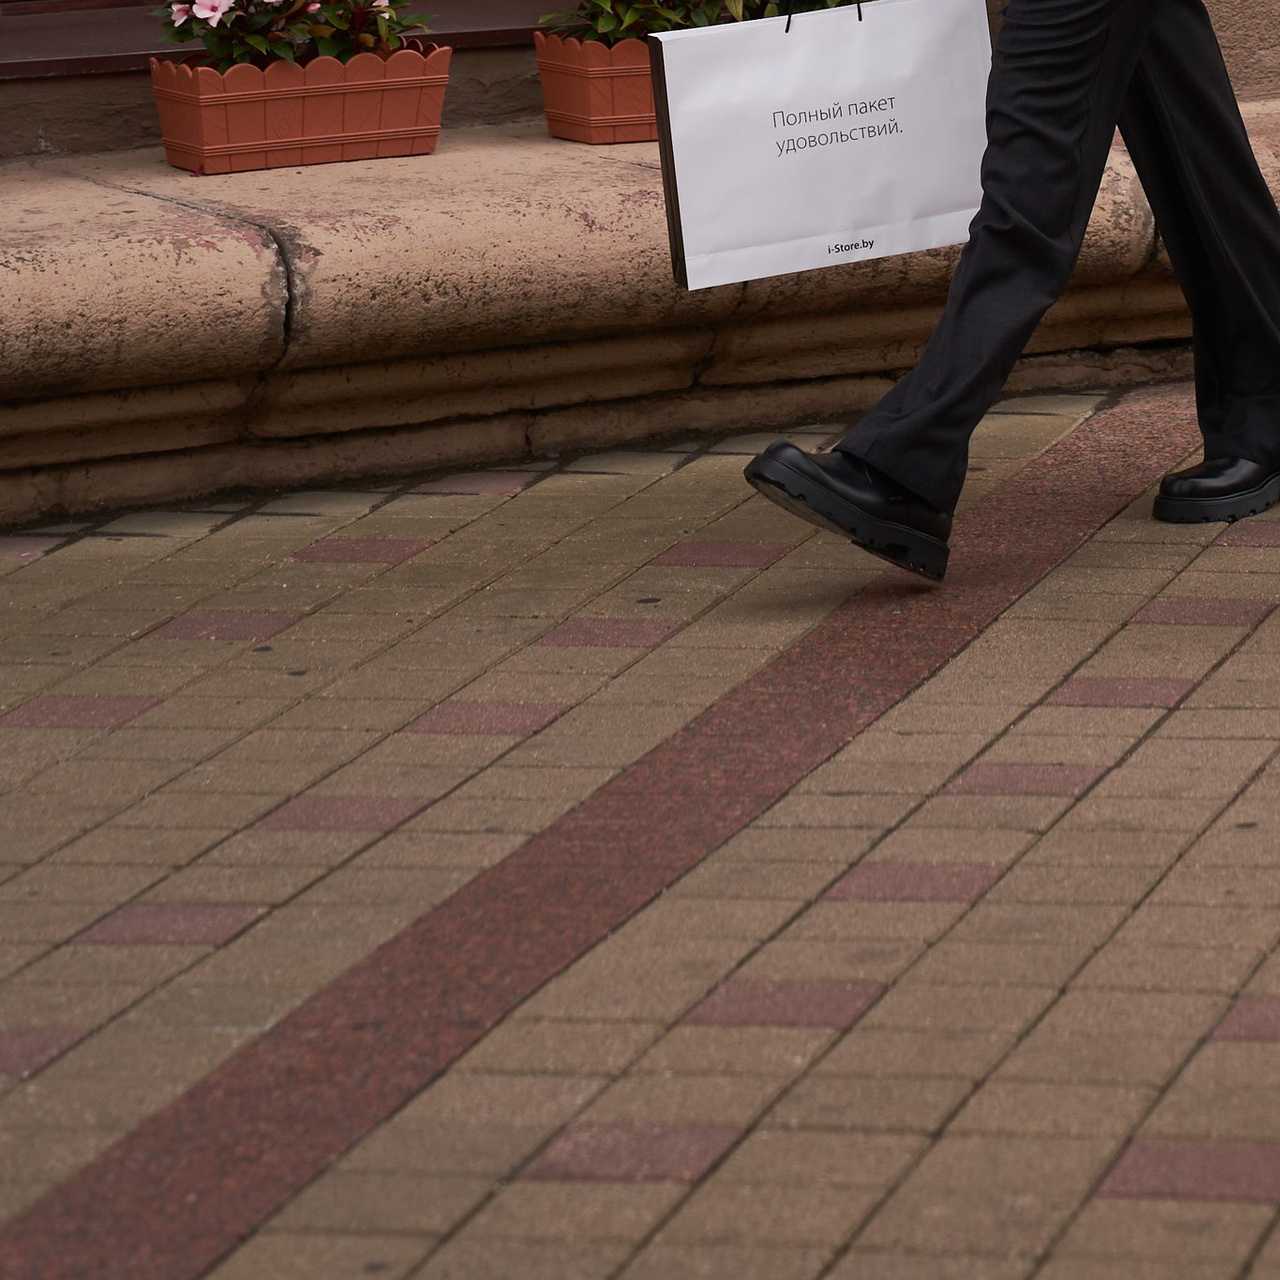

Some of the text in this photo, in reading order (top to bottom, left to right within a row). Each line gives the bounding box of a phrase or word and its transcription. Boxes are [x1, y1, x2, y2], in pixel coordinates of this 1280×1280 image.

[772, 96, 896, 128] Полный пакет
[775, 118, 904, 157] удовольствий.
[827, 239, 875, 255] i-Store.by
